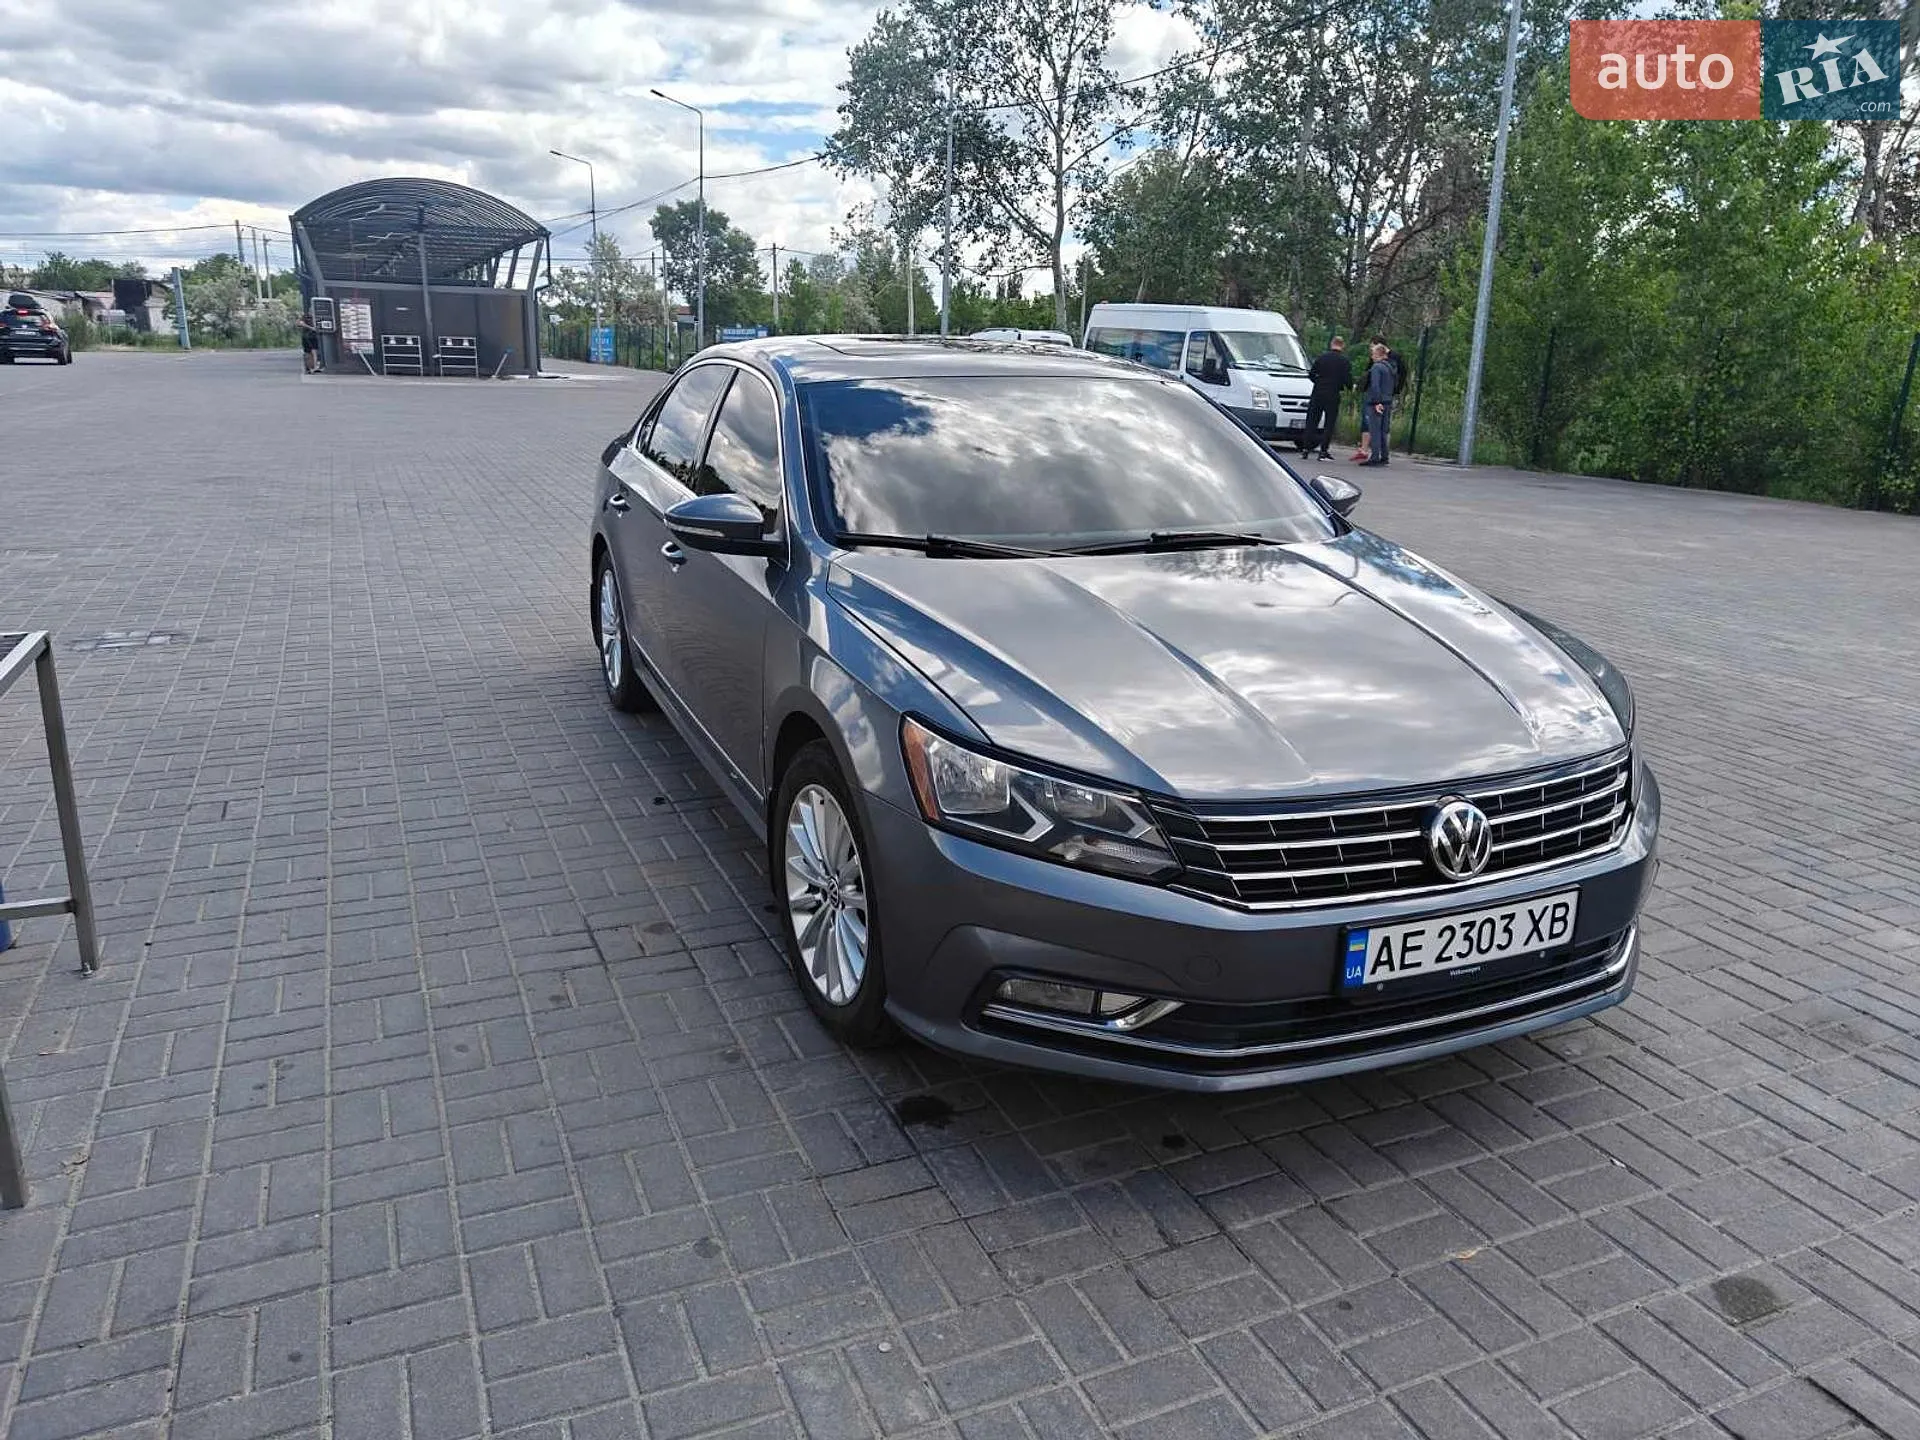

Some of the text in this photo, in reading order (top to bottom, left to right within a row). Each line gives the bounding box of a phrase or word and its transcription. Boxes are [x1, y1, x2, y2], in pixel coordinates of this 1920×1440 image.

[1370, 902, 1570, 975] AE 2303 XB
[1346, 968, 1362, 979] UA
